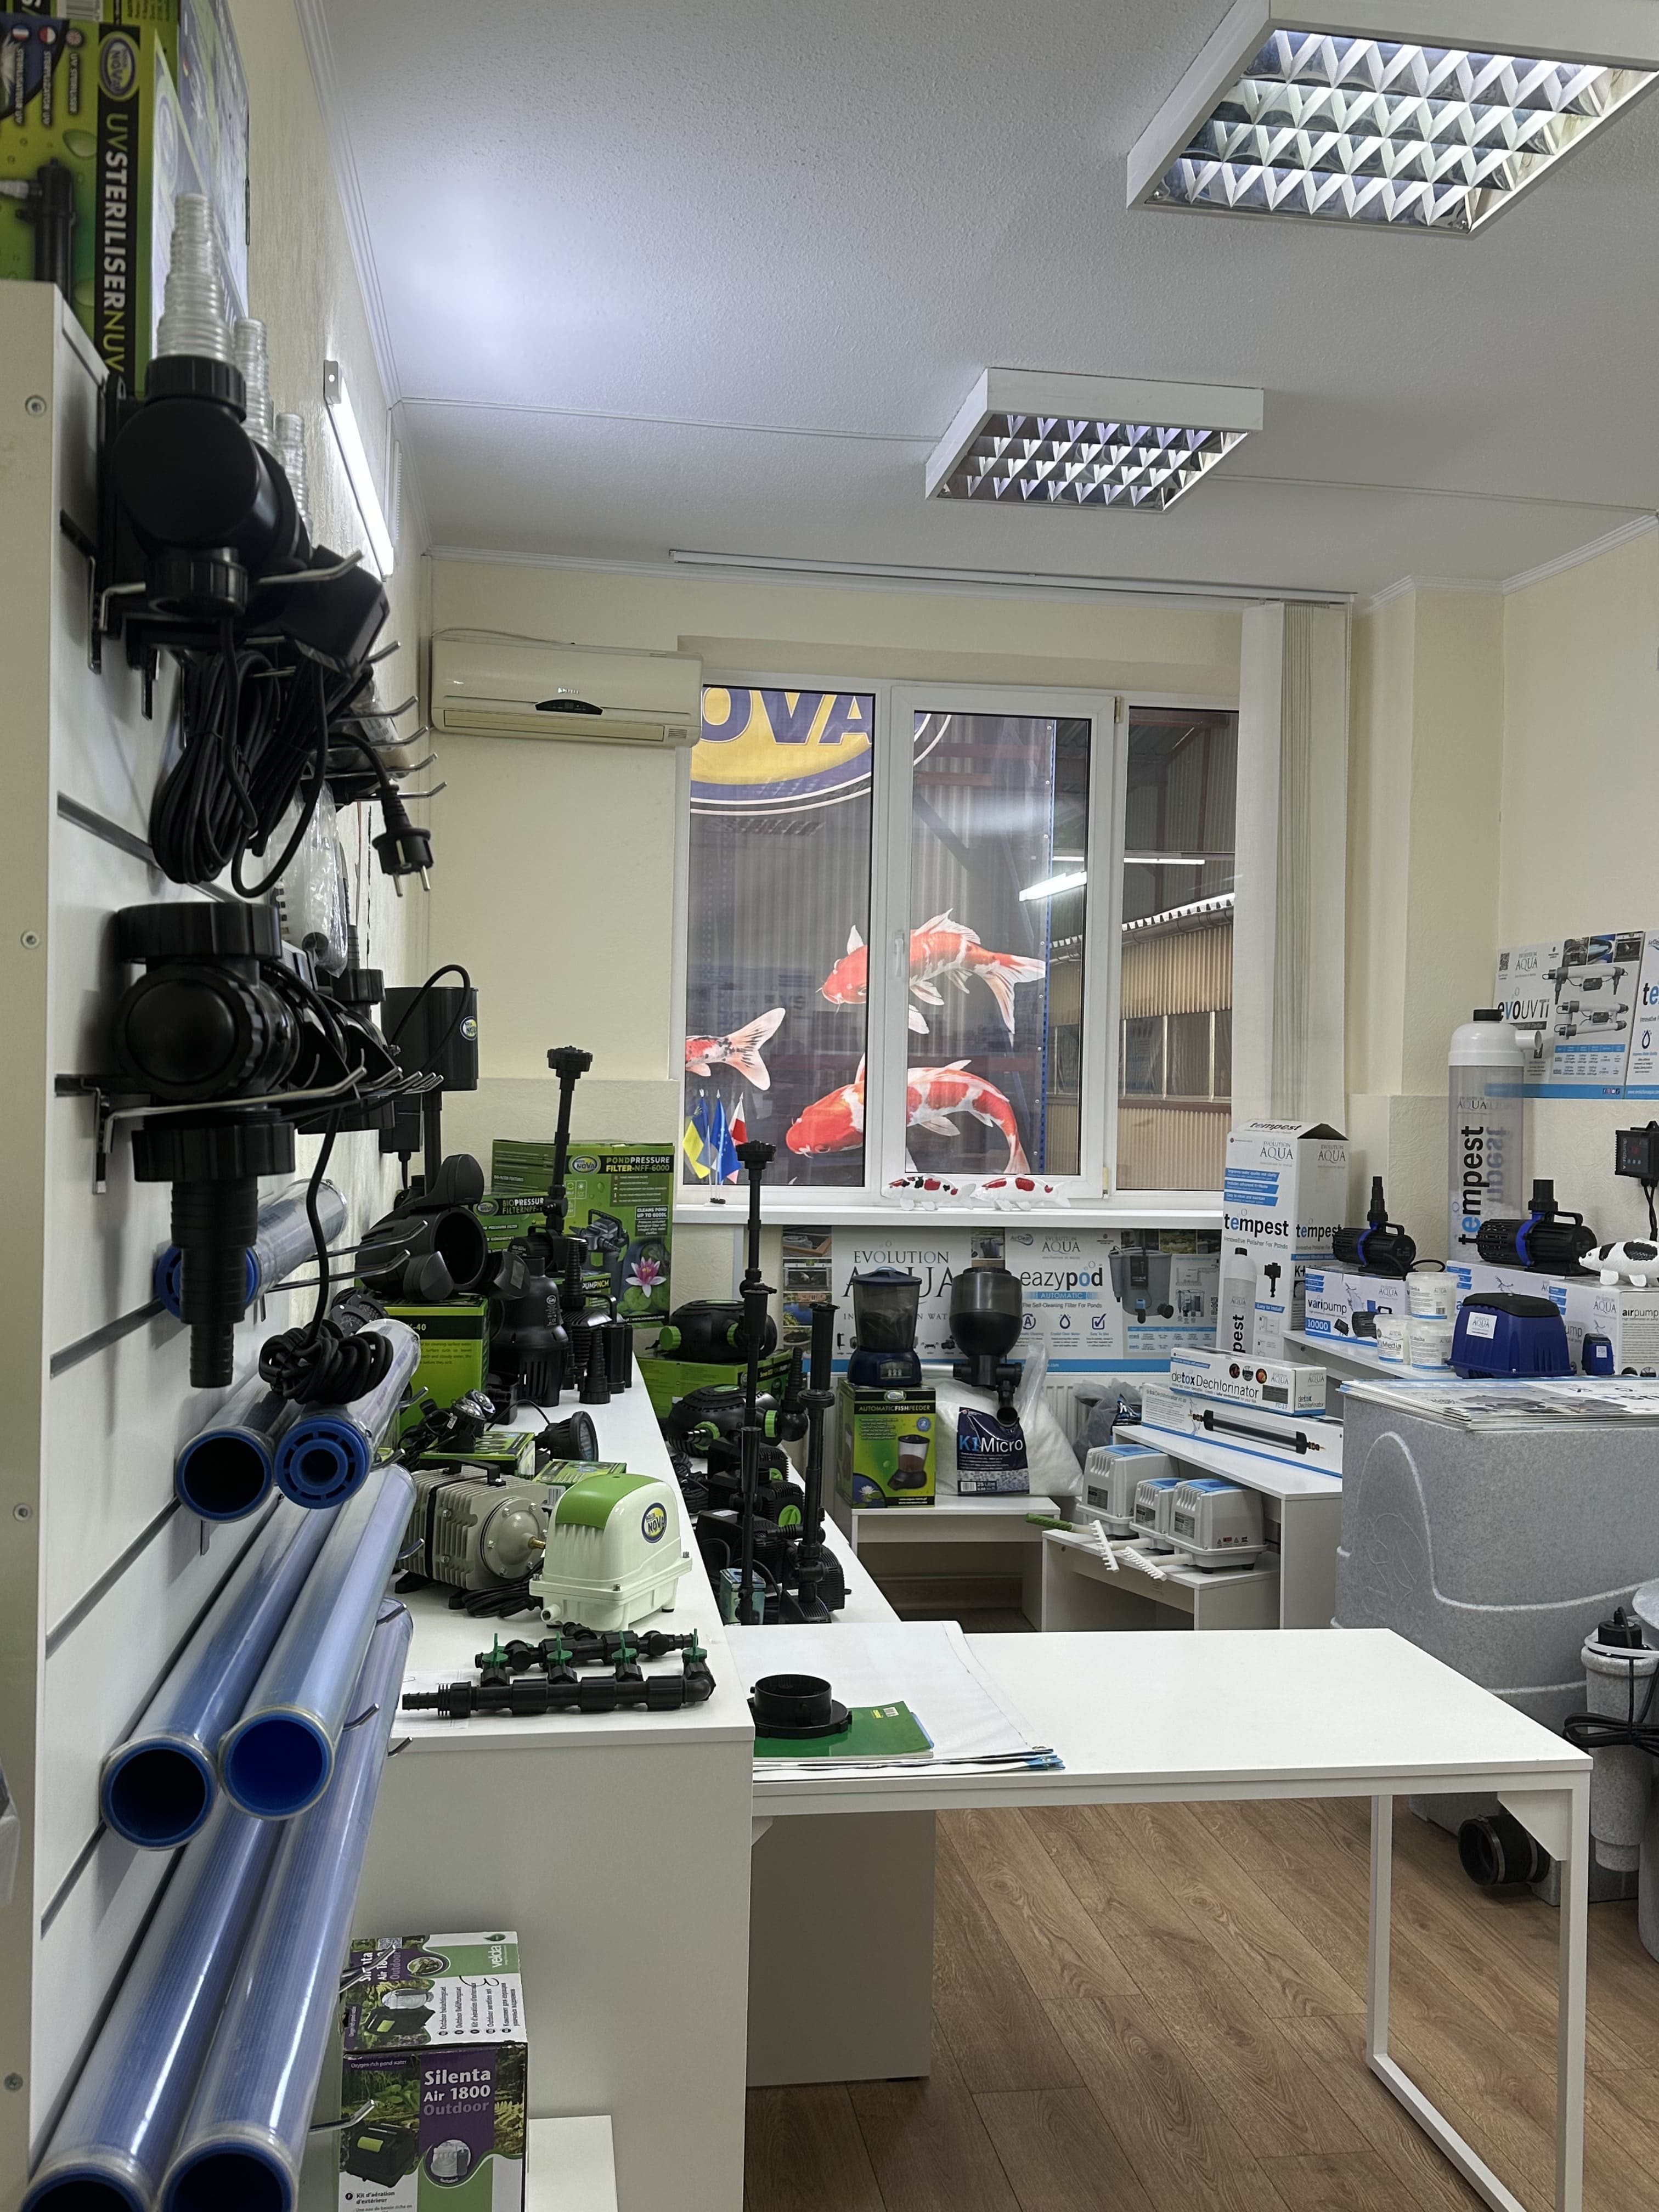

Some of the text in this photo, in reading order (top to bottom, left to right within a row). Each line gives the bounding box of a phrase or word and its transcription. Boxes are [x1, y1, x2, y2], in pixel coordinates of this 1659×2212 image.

[699, 686, 873, 746] OVA
[1516, 957, 1537, 972] AQUA
[1250, 1122, 1302, 1131] tempest
[1260, 1147, 1294, 1160] AQUA
[1318, 1150, 1346, 1163] AQUA
[1458, 1126, 1490, 1245] tempest
[503, 1198, 544, 1206] BIOPRESSUR
[1224, 1214, 1289, 1238] tempest
[1296, 1224, 1341, 1242] tempest
[1042, 1241, 1081, 1254] AQUA
[1246, 1238, 1265, 1247] Polisher
[854, 1250, 949, 1263] EVOLUTION
[840, 1266, 953, 1304] AUA
[1020, 1267, 1103, 1291] eazypod
[1379, 1289, 1398, 1297] AQUA
[1308, 1299, 1347, 1313] varipump
[1593, 1300, 1616, 1314] AQUA
[1622, 1308, 1659, 1318] airpump
[1307, 1319, 1328, 1330] 10000
[1472, 1319, 1489, 1328] AQUA
[1233, 1314, 1246, 1353] pest
[1271, 1375, 1289, 1385] AQUA
[1308, 1375, 1324, 1384] AQUA
[648, 1515, 666, 1533] NOVA
[488, 1945, 503, 1968] velda
[390, 1951, 402, 1980] Outdoor
[377, 1971, 387, 1980] Air
[424, 2068, 491, 2085] Silenta
[424, 2085, 491, 2102] Air 1800
[424, 2101, 489, 2116] Outdoor
